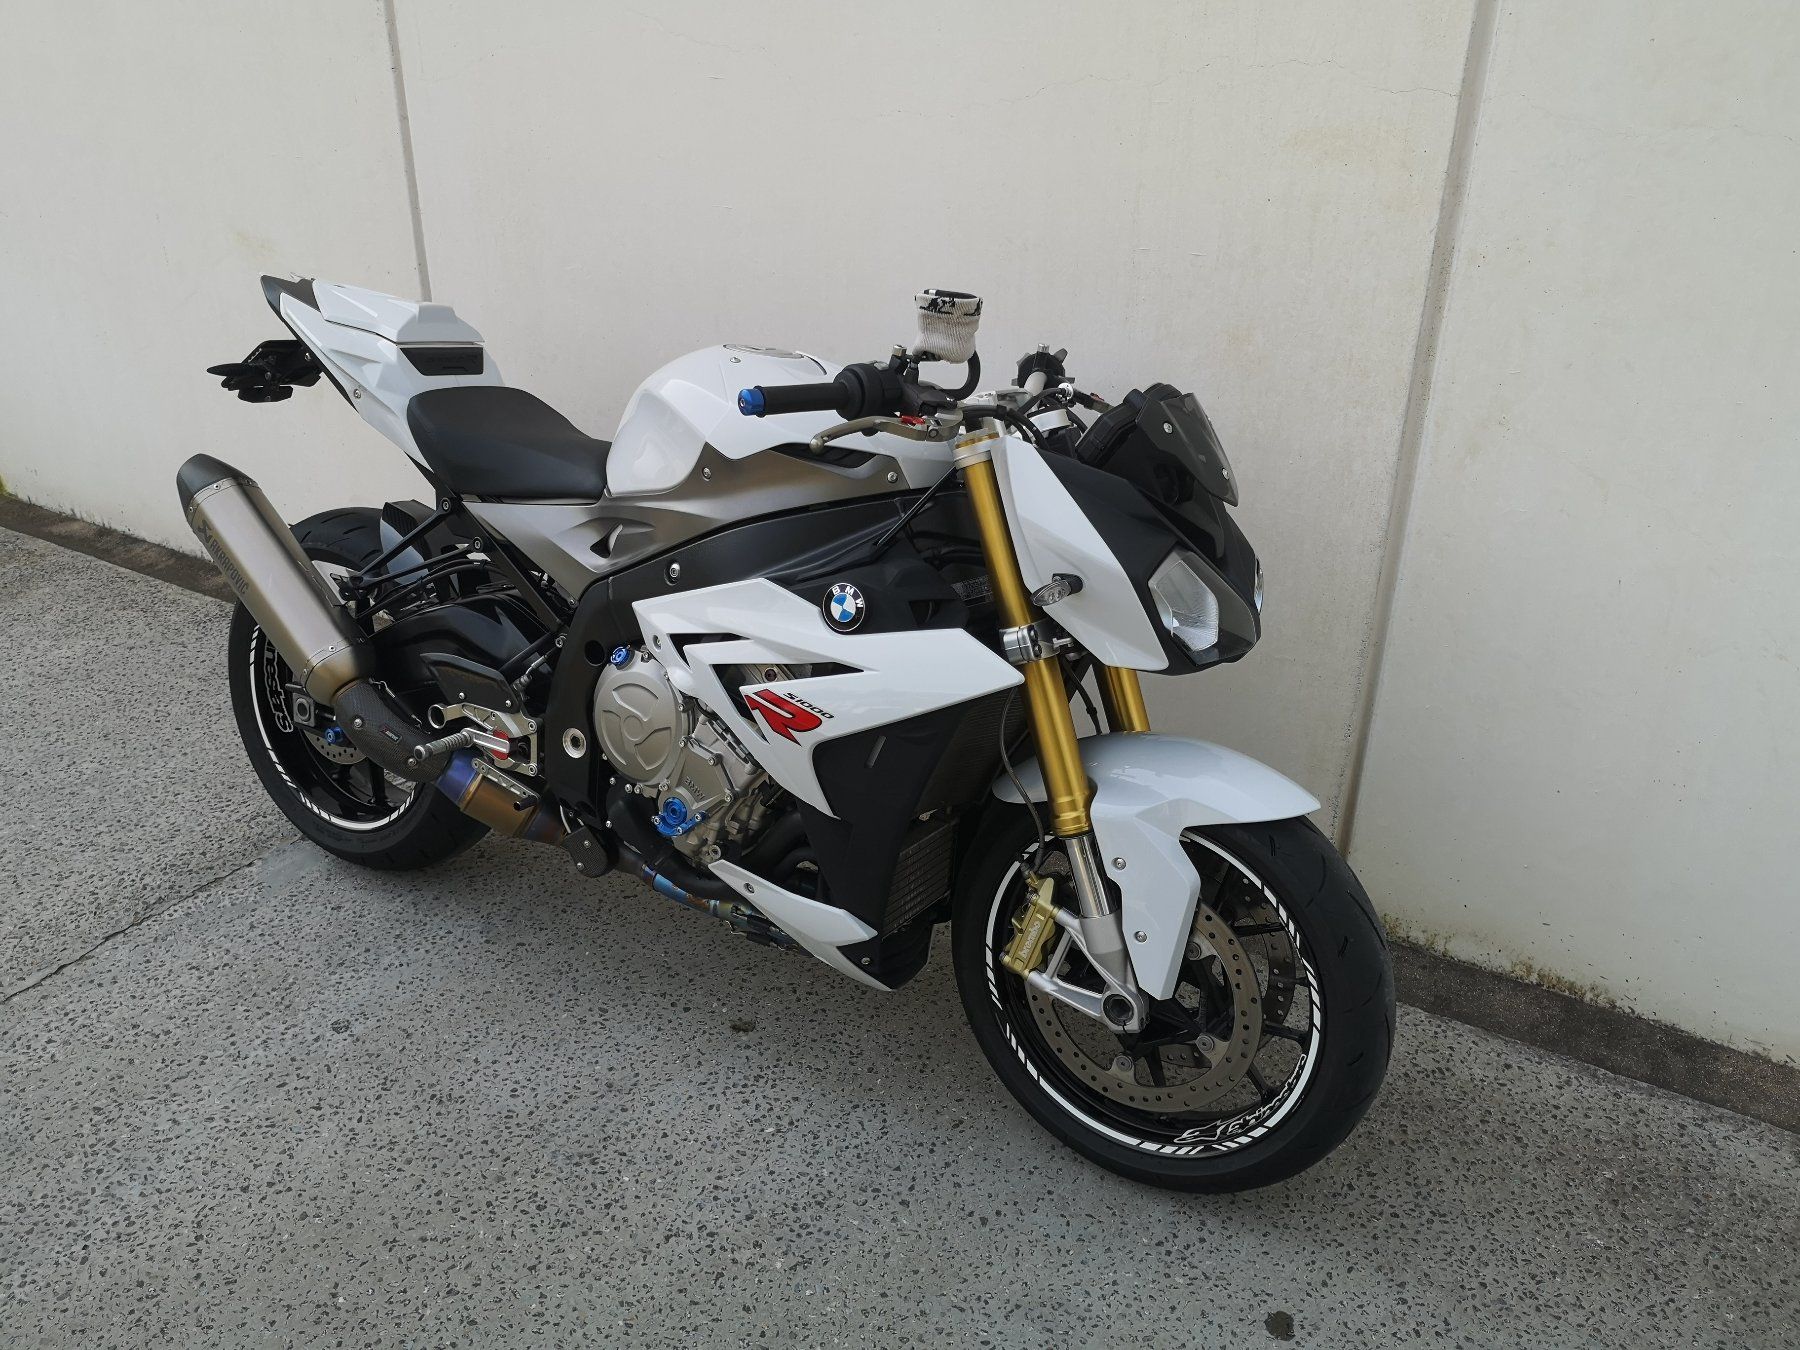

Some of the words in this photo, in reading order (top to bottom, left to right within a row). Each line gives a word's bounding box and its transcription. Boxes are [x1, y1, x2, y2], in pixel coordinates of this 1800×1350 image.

[832, 585, 864, 608] BMW
[744, 688, 823, 747] R
[783, 692, 834, 719] S1000
